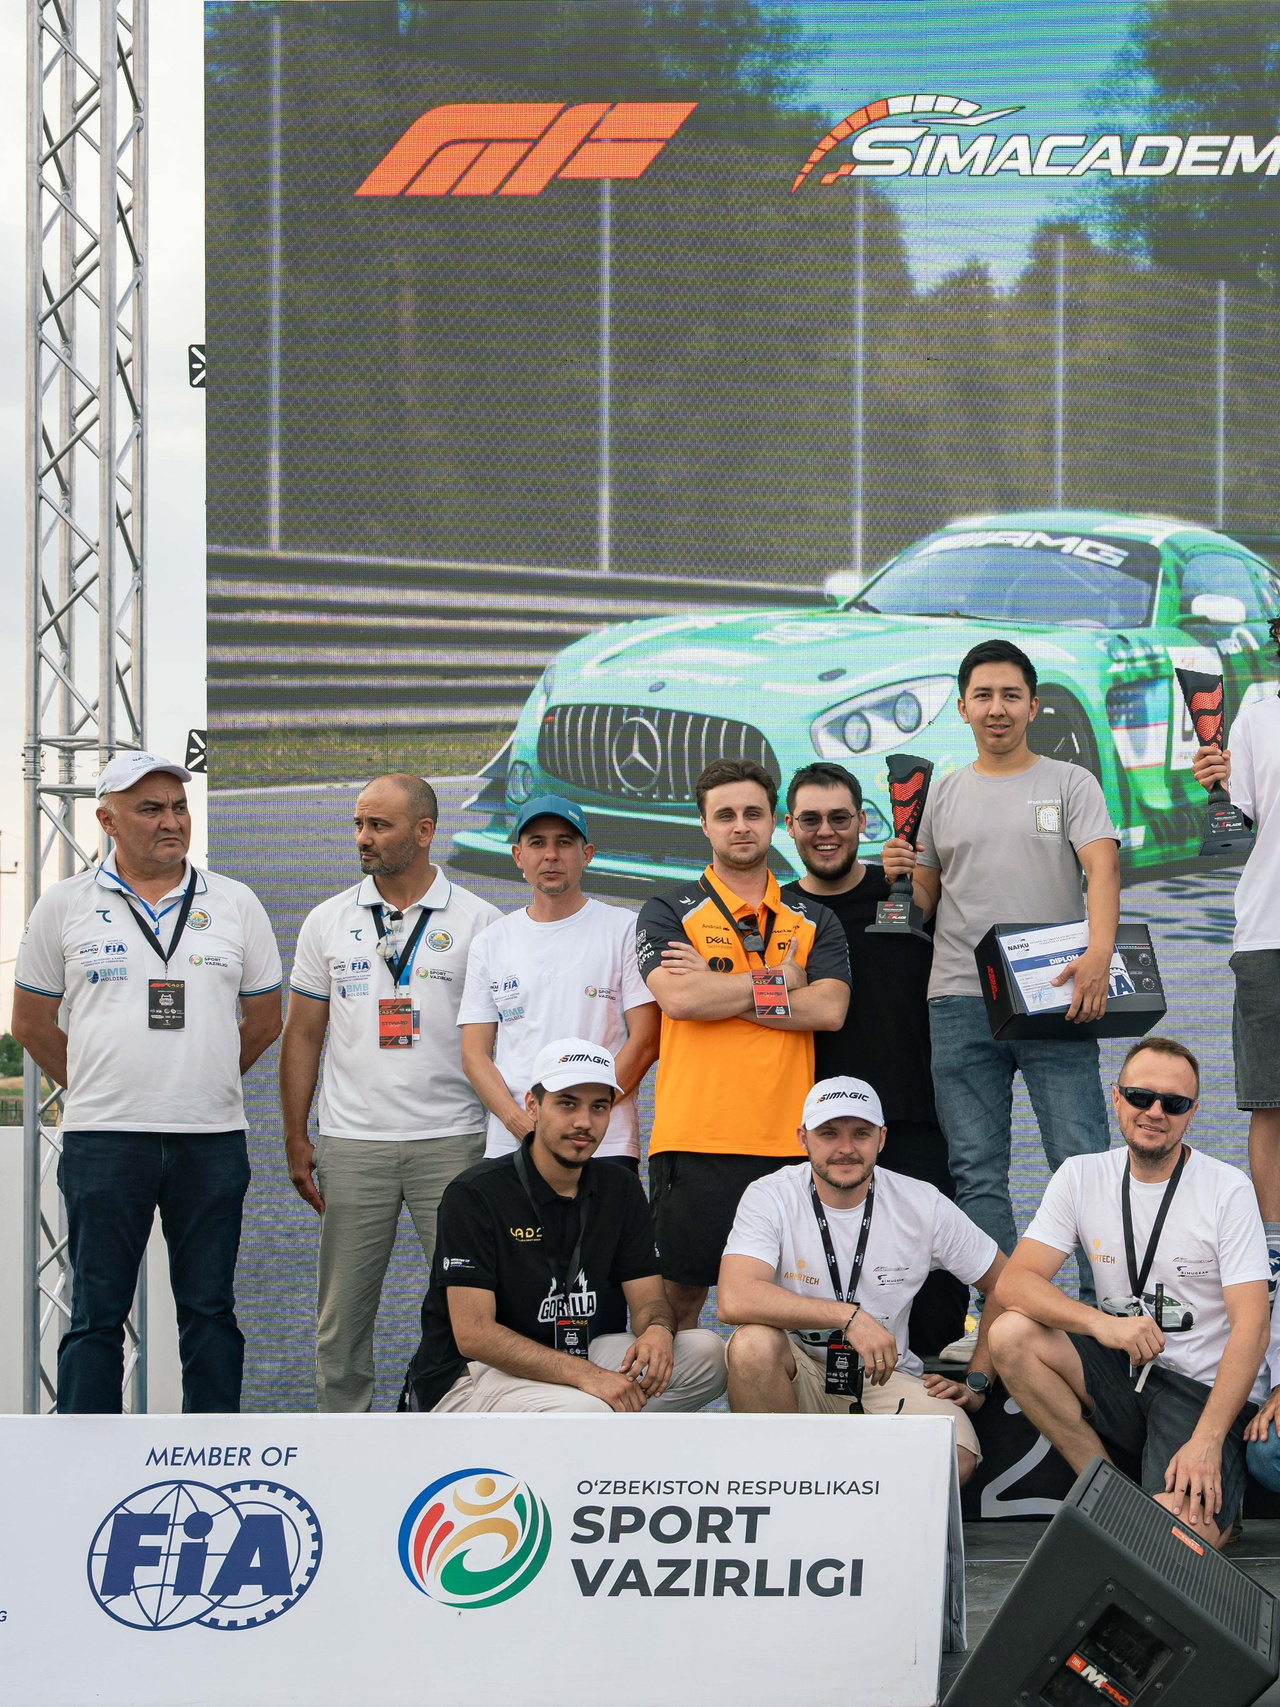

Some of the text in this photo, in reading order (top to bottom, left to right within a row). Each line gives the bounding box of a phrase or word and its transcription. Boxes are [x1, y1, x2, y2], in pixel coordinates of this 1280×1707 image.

[706, 936, 733, 945] DELL
[1008, 943, 1029, 951] NAFKU
[99, 967, 127, 977] BMB
[346, 983, 369, 992] BMB
[502, 1006, 525, 1017] BMB
[560, 1054, 610, 1067] SIMAGIC
[820, 1091, 870, 1102] SIMAGIC
[541, 1295, 595, 1319] GORLLA
[145, 1446, 298, 1467] MEMBER OF
[726, 1479, 880, 1496] RESPUBLIKASI
[570, 1504, 771, 1544] SPORT
[571, 1558, 865, 1597] VAZIRLIGI
